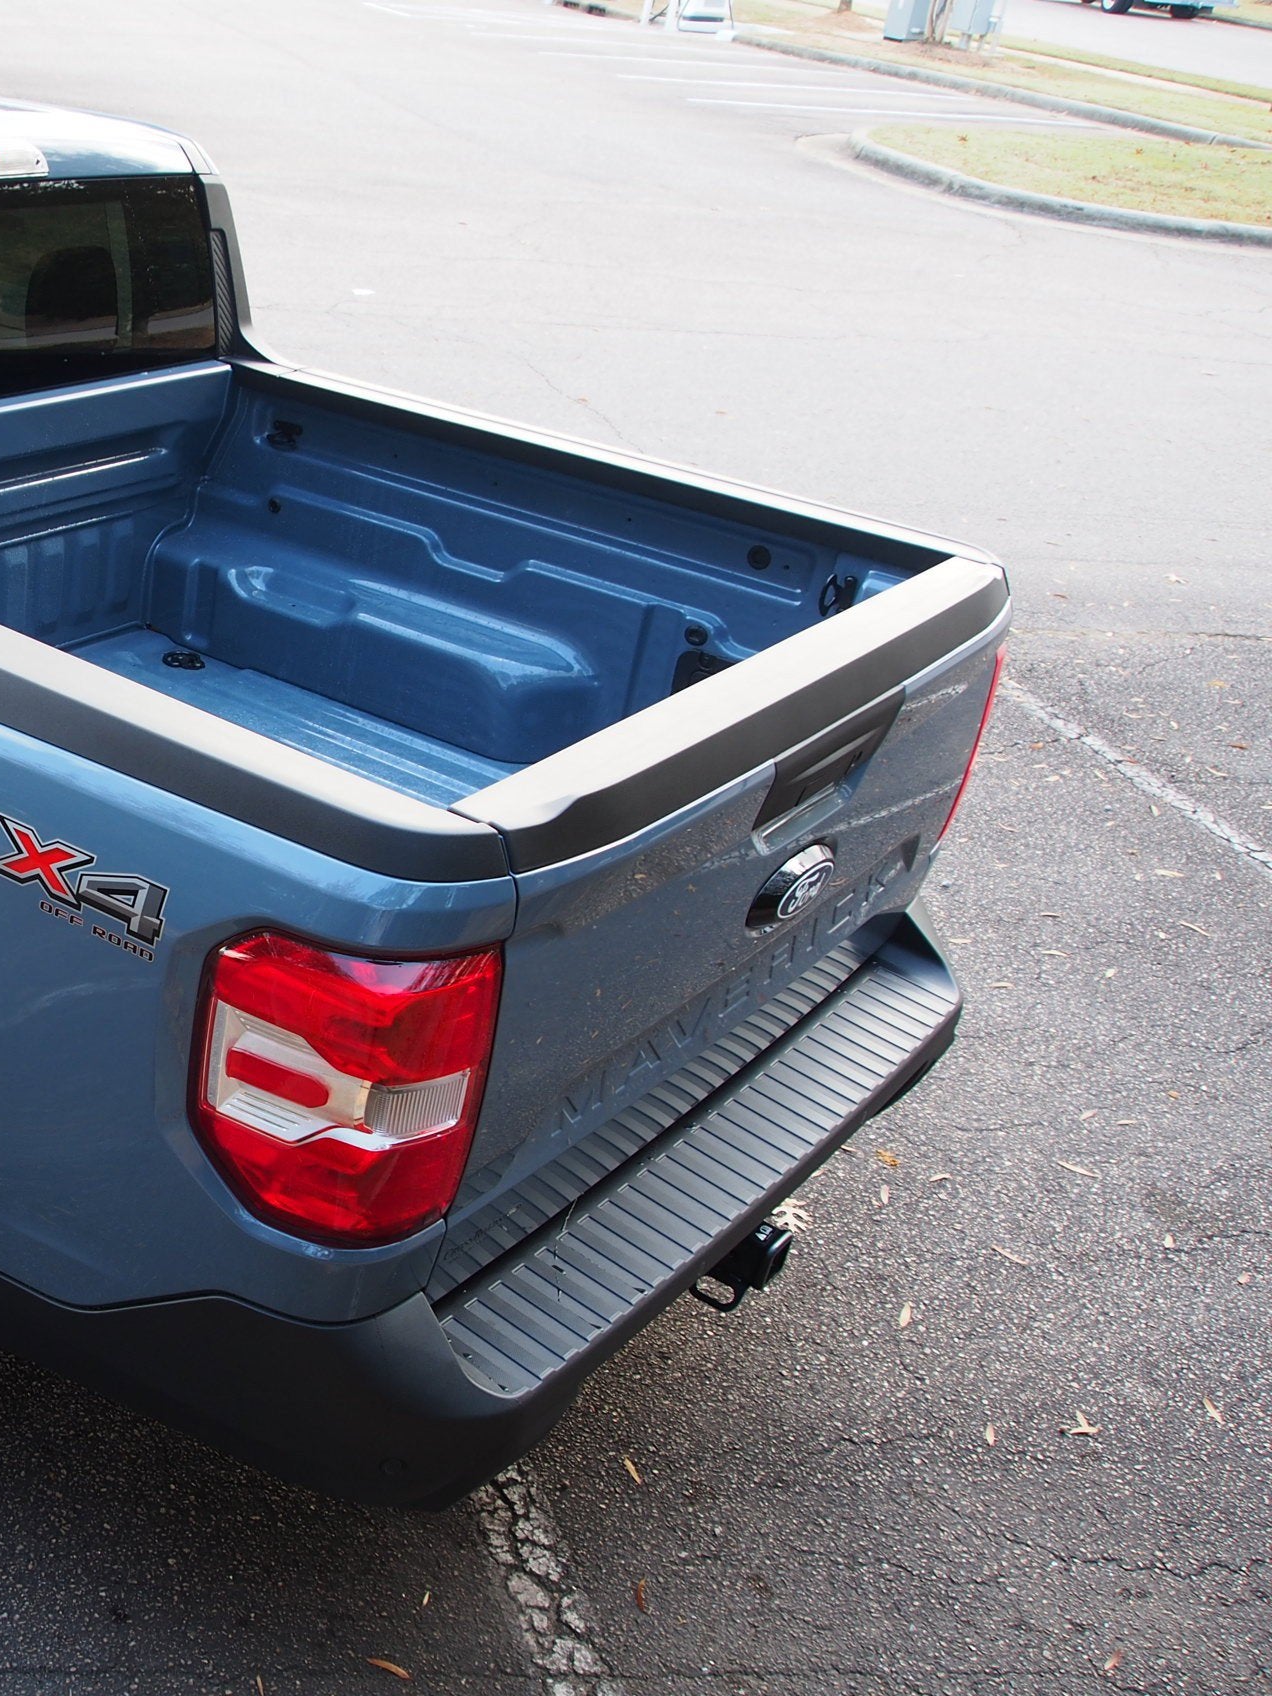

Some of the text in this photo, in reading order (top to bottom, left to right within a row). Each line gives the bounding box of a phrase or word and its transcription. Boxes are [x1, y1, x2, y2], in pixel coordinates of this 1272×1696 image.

[787, 871, 826, 913] Ford
[39, 900, 155, 962] OFF ROAD
[550, 857, 904, 1138] MAVERICK
